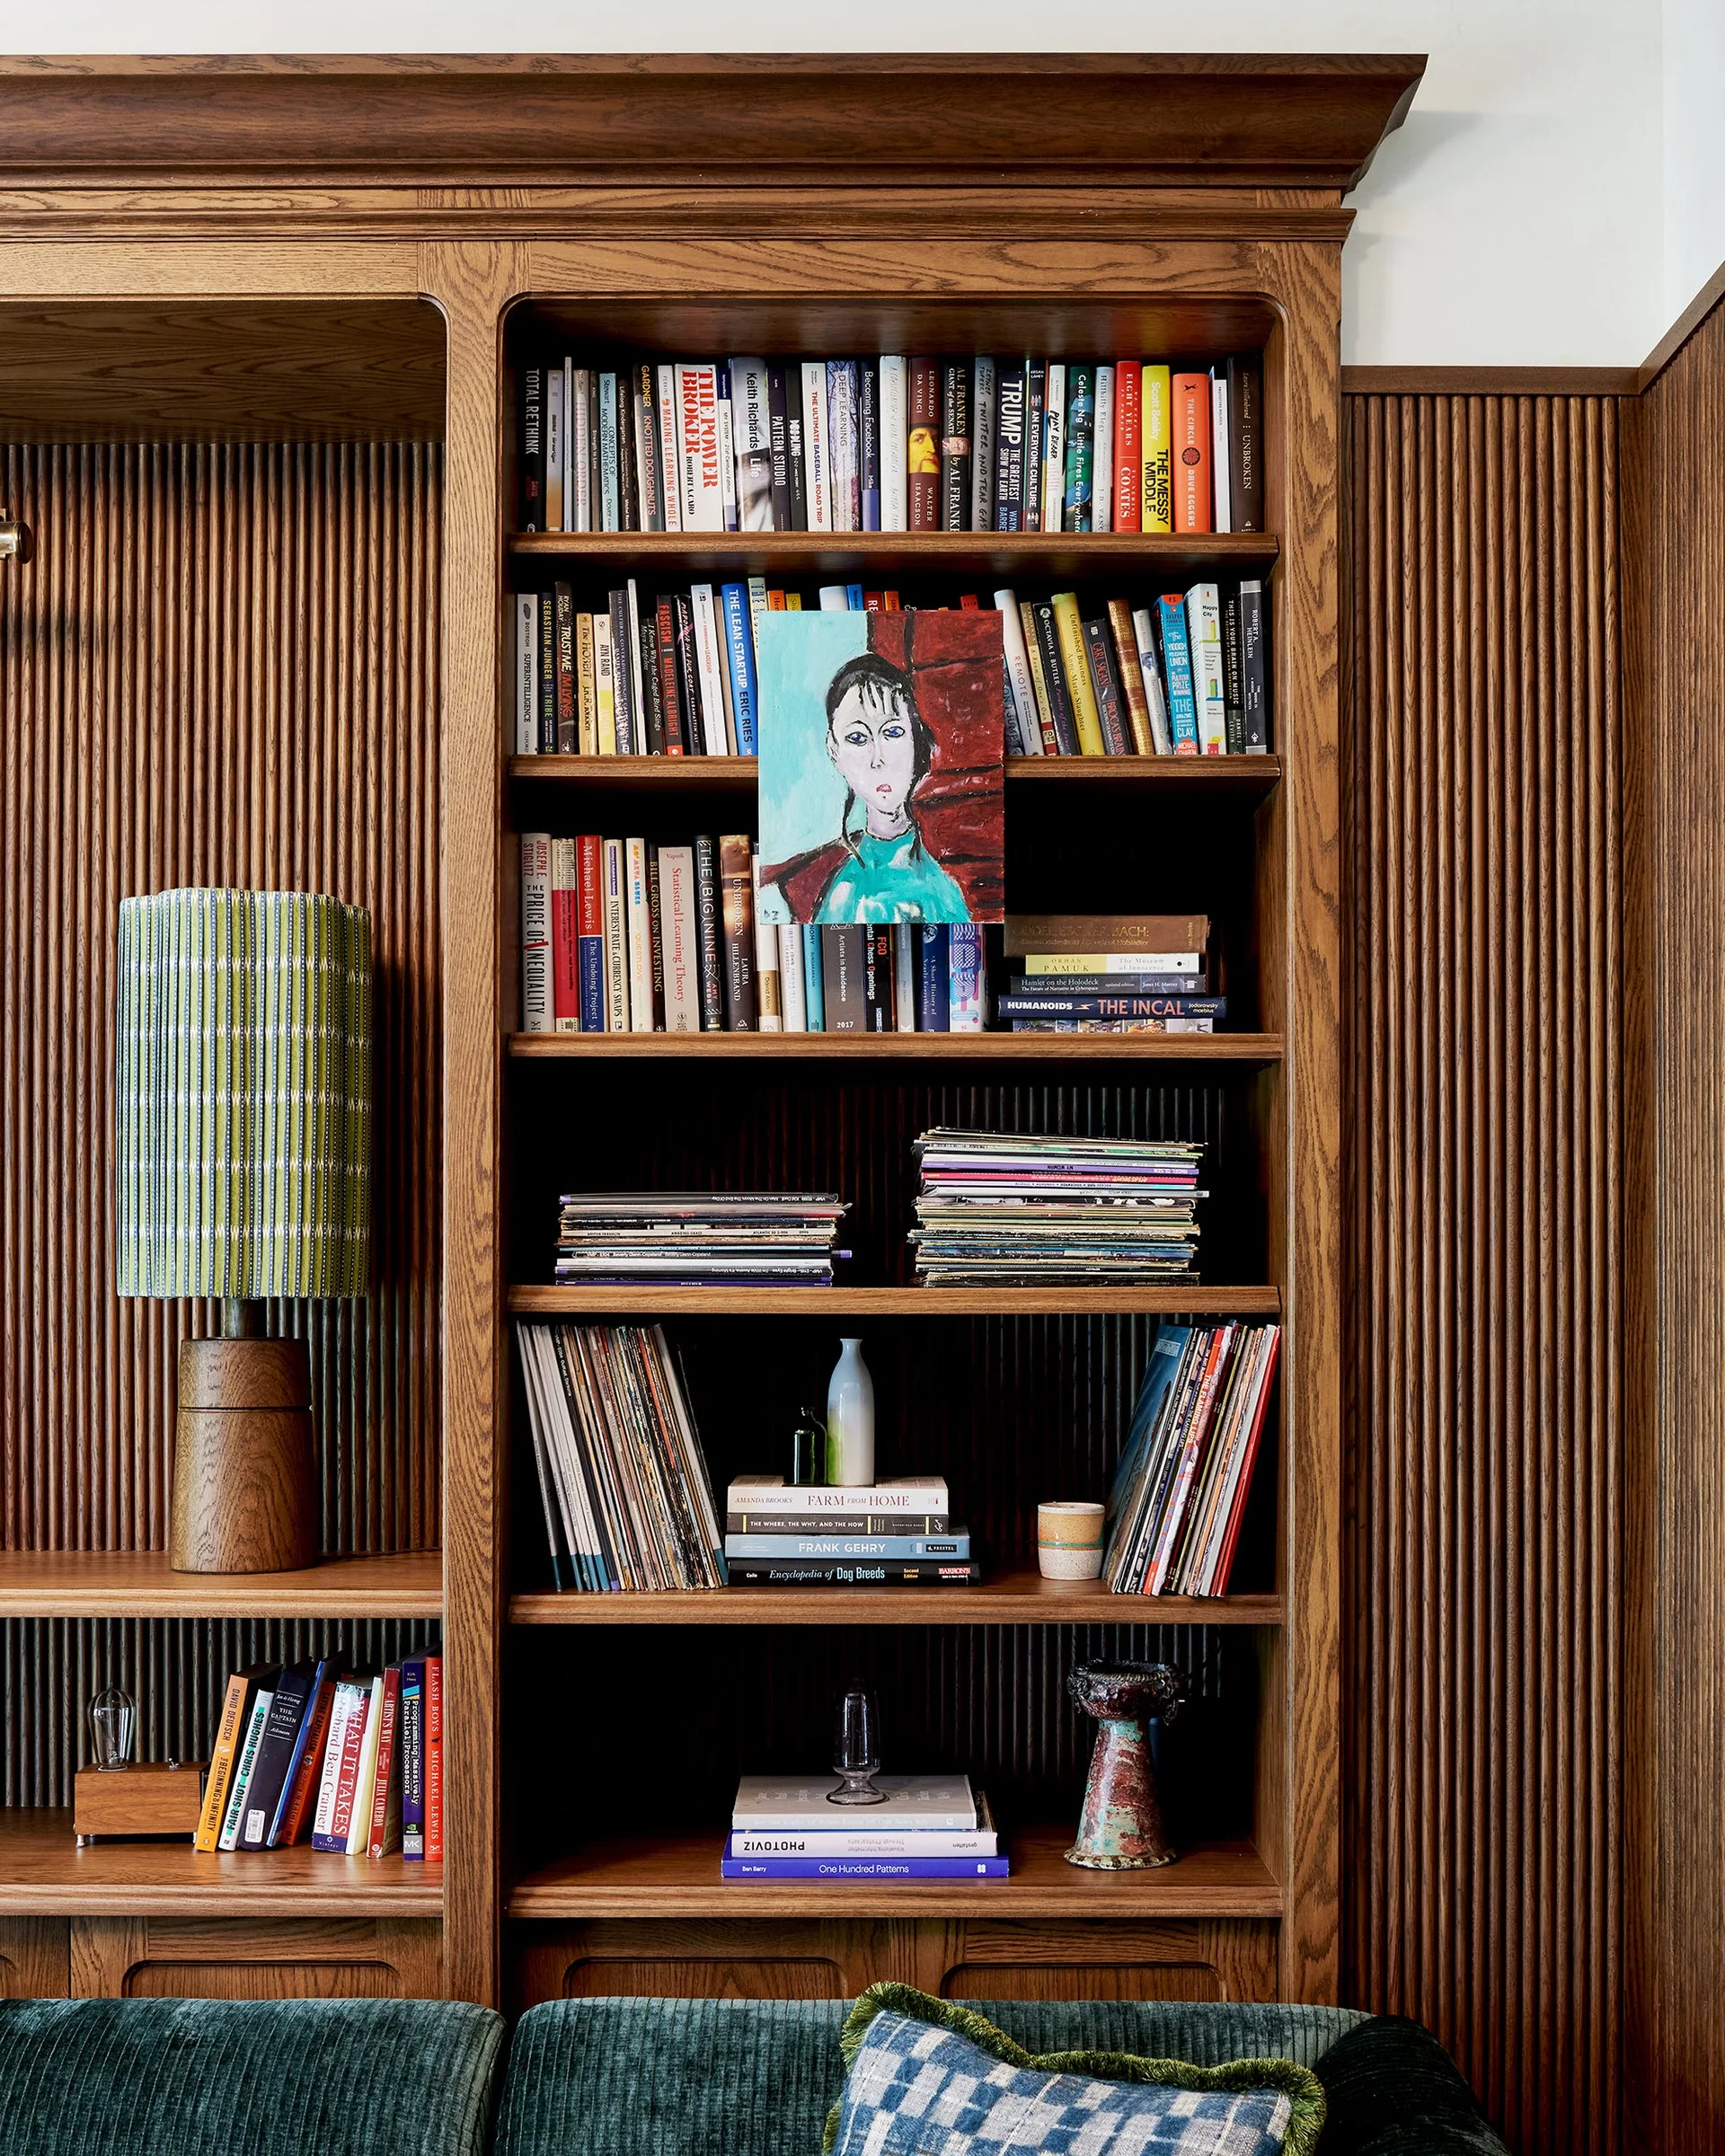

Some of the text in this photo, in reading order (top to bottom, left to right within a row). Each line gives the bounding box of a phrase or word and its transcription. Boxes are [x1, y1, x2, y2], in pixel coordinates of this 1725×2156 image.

[526, 368, 539, 455] TOTAL RETHINK
[641, 366, 650, 407] GARDNER
[747, 373, 759, 448] Keith Richards
[1076, 376, 1086, 423] Celeste Ng
[683, 371, 701, 454] BROKER
[702, 368, 718, 488] THE POWER
[839, 401, 847, 446] LEARNING
[863, 372, 874, 458] Becoming Facebook
[1001, 380, 1022, 444] TRUMP
[644, 416, 656, 515] KNOTTED DOUGHNUTS
[663, 409, 677, 526] MAKING LEARNING WHOLE
[750, 458, 762, 477] Life
[772, 416, 785, 485] PATTERN STUDIO
[999, 448, 1008, 500] SHOW ON EARTH
[1009, 449, 1021, 500] THE GREATEST
[1030, 411, 1039, 508] AN EVERYONE CULTURE
[1075, 432, 1085, 478] Little Fires
[1243, 435, 1251, 490] UNBROKEN
[1120, 466, 1130, 517] COATES
[1145, 462, 1155, 512] MIDDLE
[1157, 449, 1168, 525] THE MESSY
[659, 605, 671, 642] FASCISM
[730, 590, 747, 688] THE LEAN STARTUP
[544, 648, 552, 680] JUNGER
[600, 644, 609, 676] AYN RAND
[648, 650, 656, 663] Why
[1014, 657, 1027, 697] REMOTE
[544, 694, 553, 717] TRIBE
[650, 677, 659, 696] Caged
[664, 658, 678, 736] MADELEINE ALBRIGHT
[1174, 699, 1191, 712] THE
[739, 692, 752, 742] ERIC RIES
[524, 844, 533, 877] STIGLITZ
[537, 841, 546, 870] JOSEPH
[583, 845, 594, 929] Michael Lewis
[701, 847, 715, 962] THE BIG NINE
[733, 879, 742, 935] UNBROKEN
[526, 893, 544, 1013] PRICE OF INEQUALITY
[672, 868, 685, 1002] Statistical Learning Theory
[878, 937, 887, 955] FCO
[589, 959, 597, 990] Undoing
[589, 993, 598, 1020] Project
[1007, 1002, 1073, 1010] HUMANOIDS
[1098, 1000, 1185, 1015] THE INCAL
[1187, 1374, 1212, 1444] THE FLAMING LIPS
[808, 1496, 845, 1506] FARM
[870, 1496, 909, 1506] HOME
[799, 1543, 885, 1552] FRANK GEHRY
[770, 1567, 885, 1581] Encyclopedia of Dog Breeds
[223, 1689, 240, 1740] DAVID DEUTSCH
[381, 1699, 394, 1744] ARTIST'S WAY
[431, 1666, 439, 1731] FLASH BOYS
[227, 1712, 264, 1830] FAIR SHOT CHRIS HUGHES
[333, 1700, 365, 1834] WHAT IT TAKES
[374, 1779, 388, 1827] JULIA CAMERON
[744, 1842, 805, 1850] PHOTOVIZ
